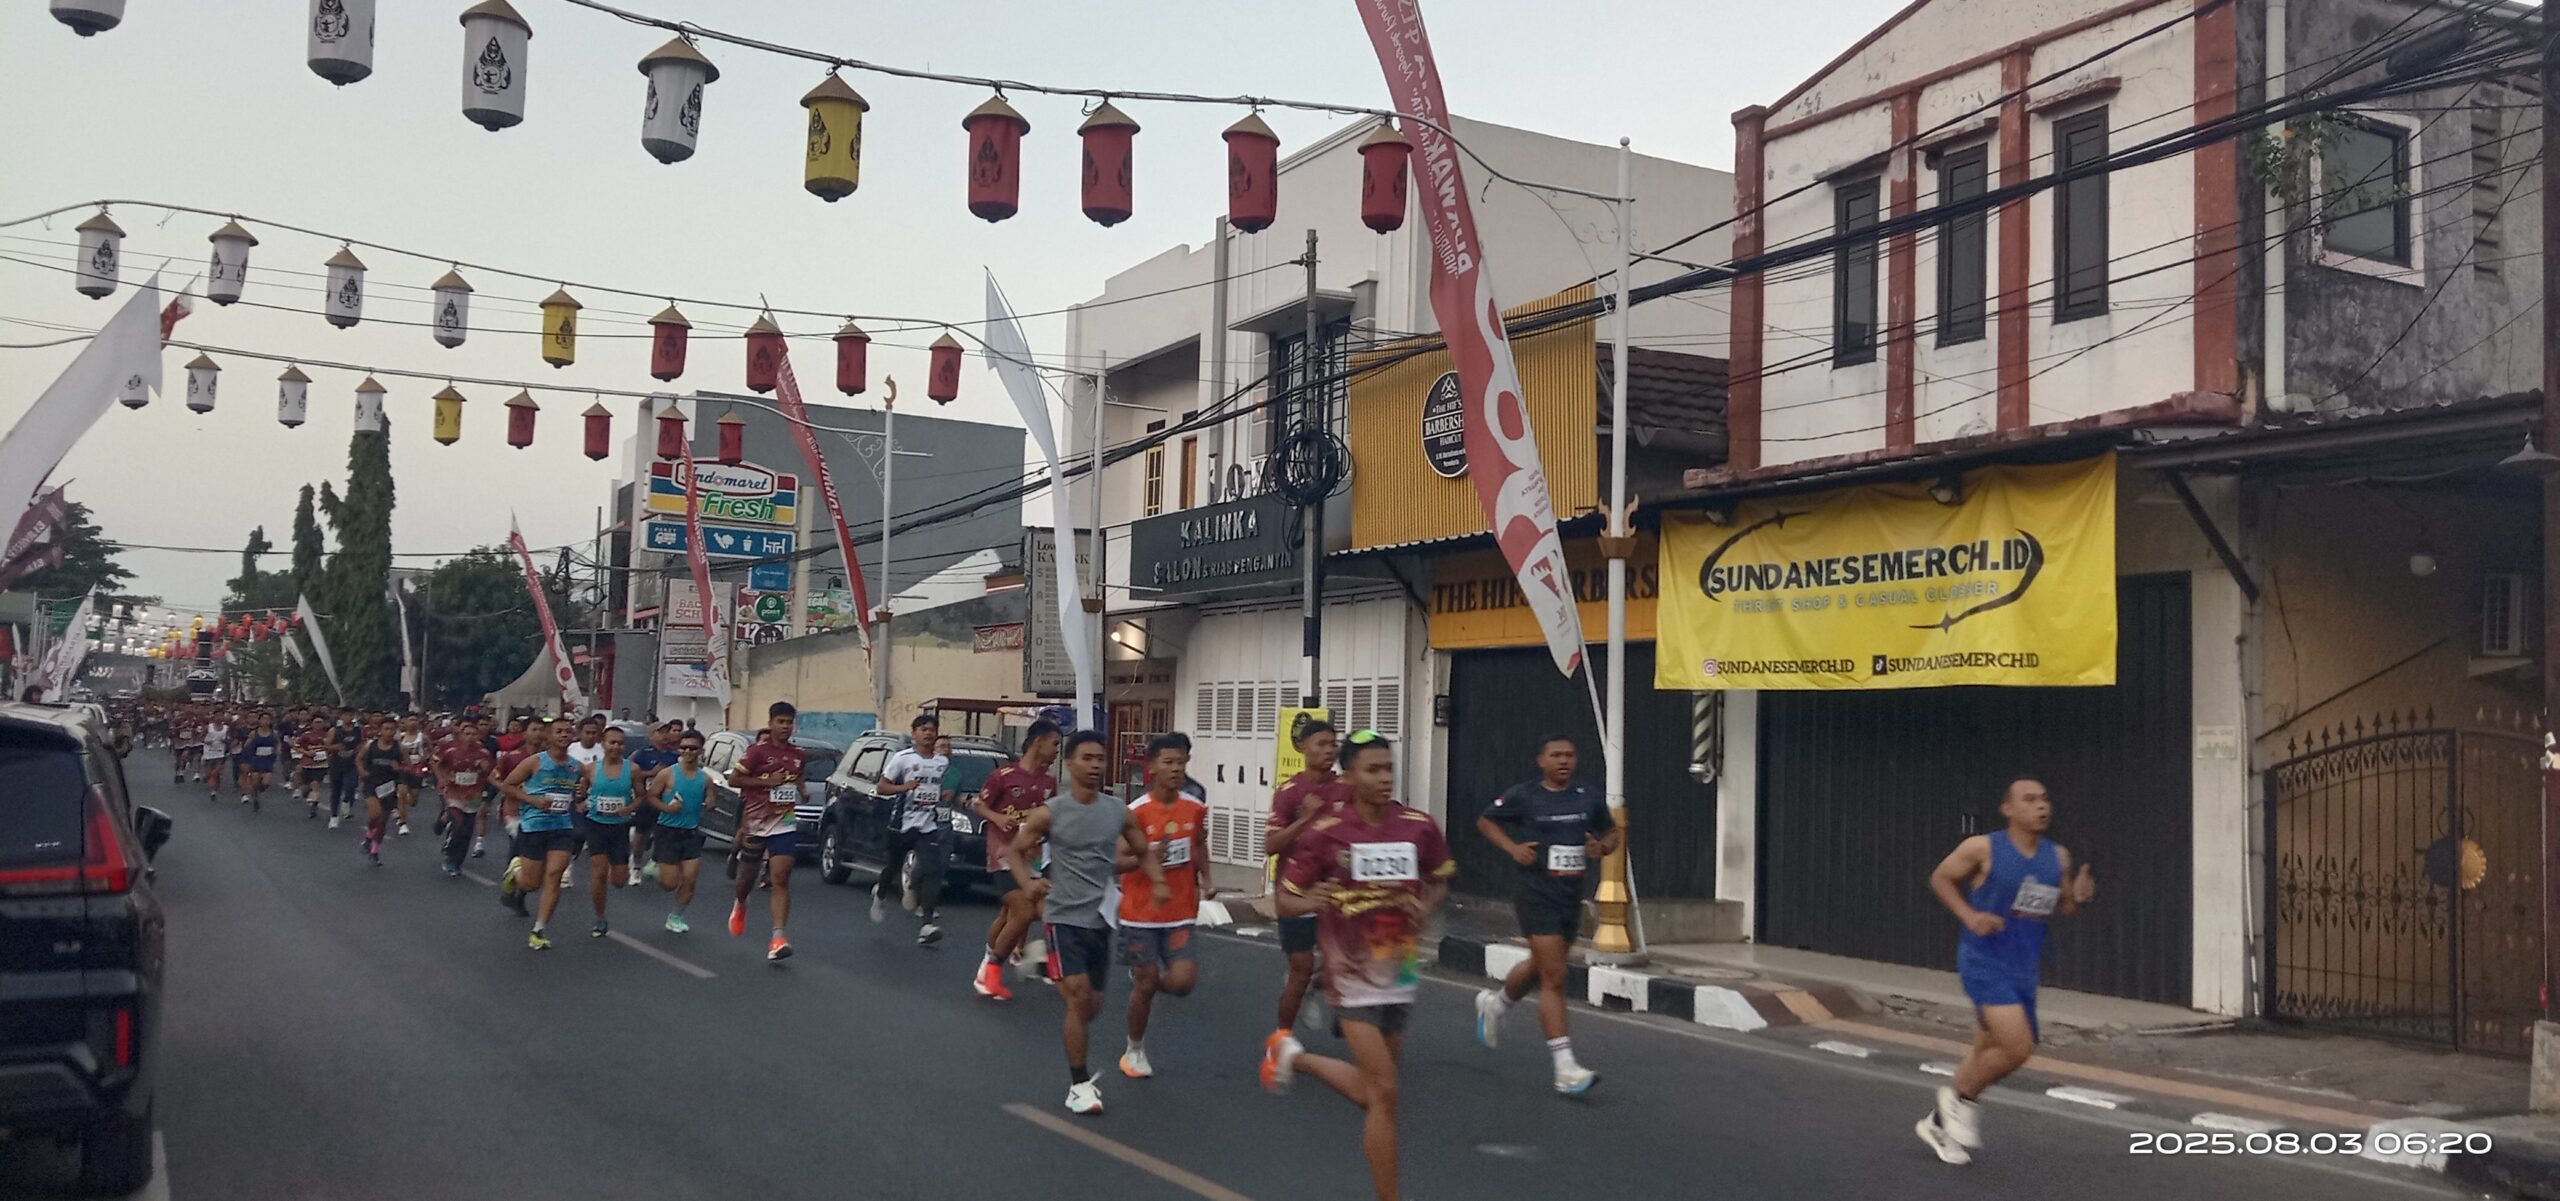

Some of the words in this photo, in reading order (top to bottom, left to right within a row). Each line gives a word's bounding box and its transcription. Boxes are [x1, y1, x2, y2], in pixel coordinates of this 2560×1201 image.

[702, 491, 776, 521] Fresh
[1181, 509, 1259, 549] KALINKA
[1154, 556, 1202, 585] SALON
[1709, 538, 2031, 595] SUNDANESEMERCH.ID
[1791, 596, 1830, 611] SHOP
[1855, 591, 1918, 608] CASUAL
[1717, 658, 1855, 675] SUNDANESEMERCH.ID
[773, 790, 794, 800] 1255
